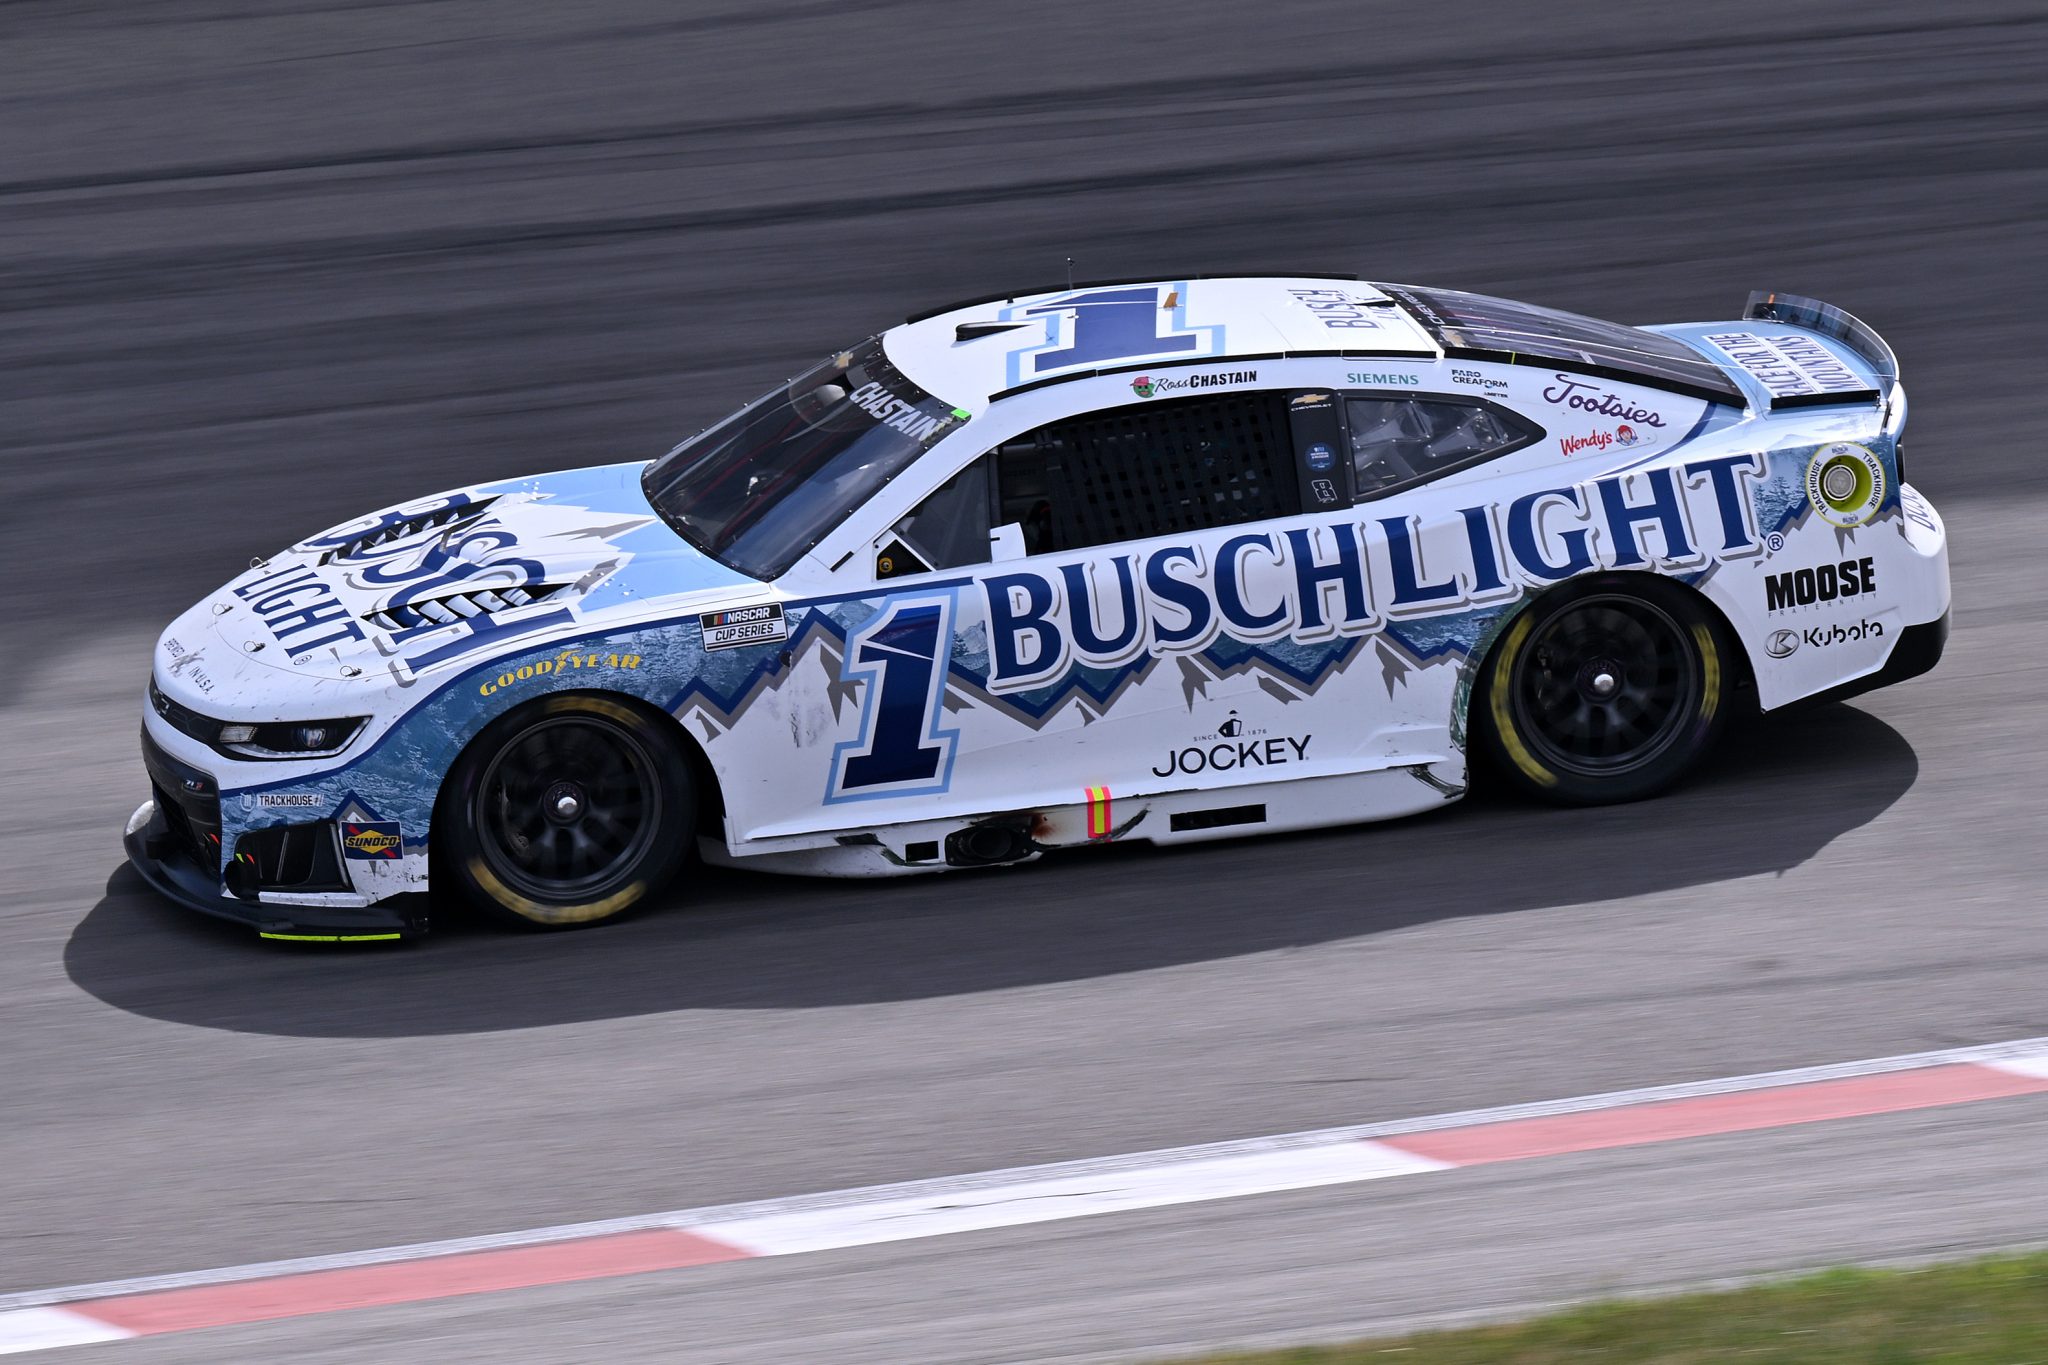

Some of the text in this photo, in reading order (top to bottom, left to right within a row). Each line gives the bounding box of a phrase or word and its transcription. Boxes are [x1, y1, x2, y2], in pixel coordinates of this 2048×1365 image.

[1288, 288, 1380, 329] BUSCH
[1012, 285, 1210, 380] 1
[1346, 372, 1419, 386] SIEMENS
[1451, 369, 1481, 378] FARO
[1708, 333, 1816, 395] RACE FOR THE
[1765, 336, 1864, 391] MOUNTAINS
[1154, 370, 1258, 393] Ross CHASTAIN
[1452, 376, 1509, 389] CREAFORM
[850, 381, 938, 442] CHASTAIN
[1290, 403, 1332, 412] CHEVROLET
[1543, 373, 1667, 428] Tootsies
[1559, 429, 1613, 457] Wendy's
[1808, 459, 1830, 516] TRACKHOUSE
[1862, 452, 1882, 510] TRACKHOUSE
[1764, 556, 1877, 612] MOOSE
[232, 563, 367, 659] LIGHT
[727, 606, 771, 624] NASCAR
[1767, 593, 1877, 619] FRATERNITY
[715, 623, 774, 642] CUP SERIES
[1803, 618, 1884, 648] Kubota
[479, 649, 641, 697] GOODYEAR
[834, 597, 951, 796] 1
[1193, 728, 1268, 742] SINCE 1876
[1152, 734, 1312, 778] JOCKEY
[259, 794, 314, 807] TRACKHOUSE
[346, 835, 400, 848] SUNOCO
